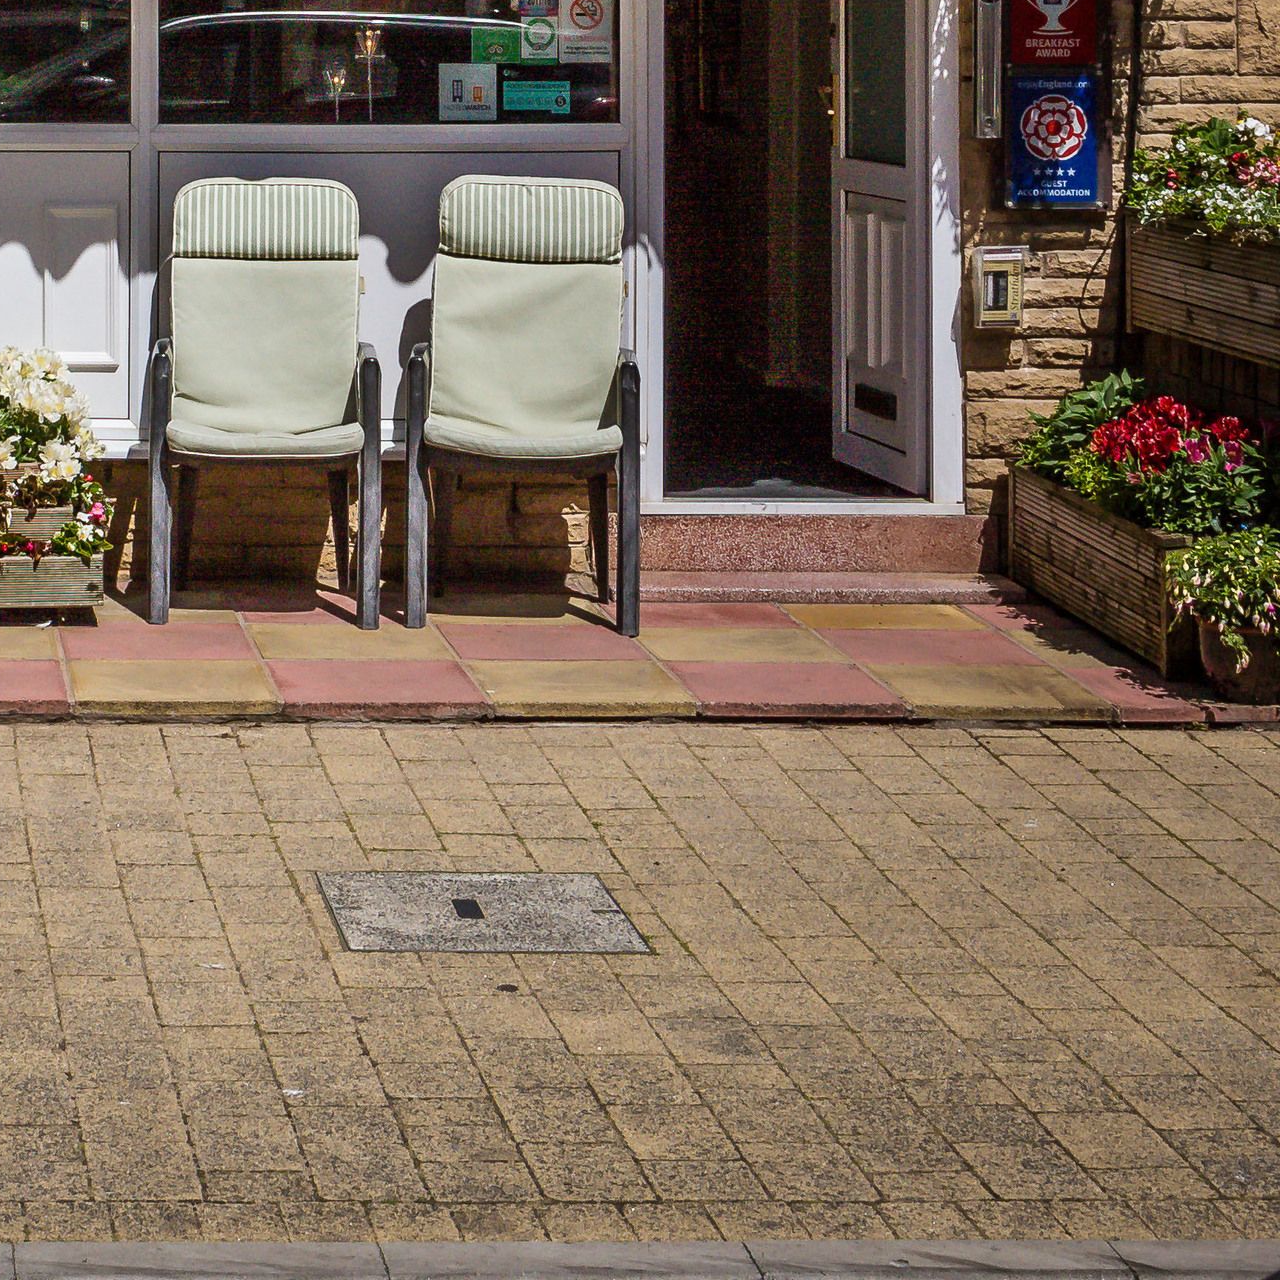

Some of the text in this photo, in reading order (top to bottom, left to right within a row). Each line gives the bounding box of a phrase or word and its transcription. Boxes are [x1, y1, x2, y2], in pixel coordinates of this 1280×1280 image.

[1025, 39, 1081, 47] BREAKFAST
[1035, 49, 1071, 57] AWARD
[1018, 189, 1090, 197] ACCOMMODATION
